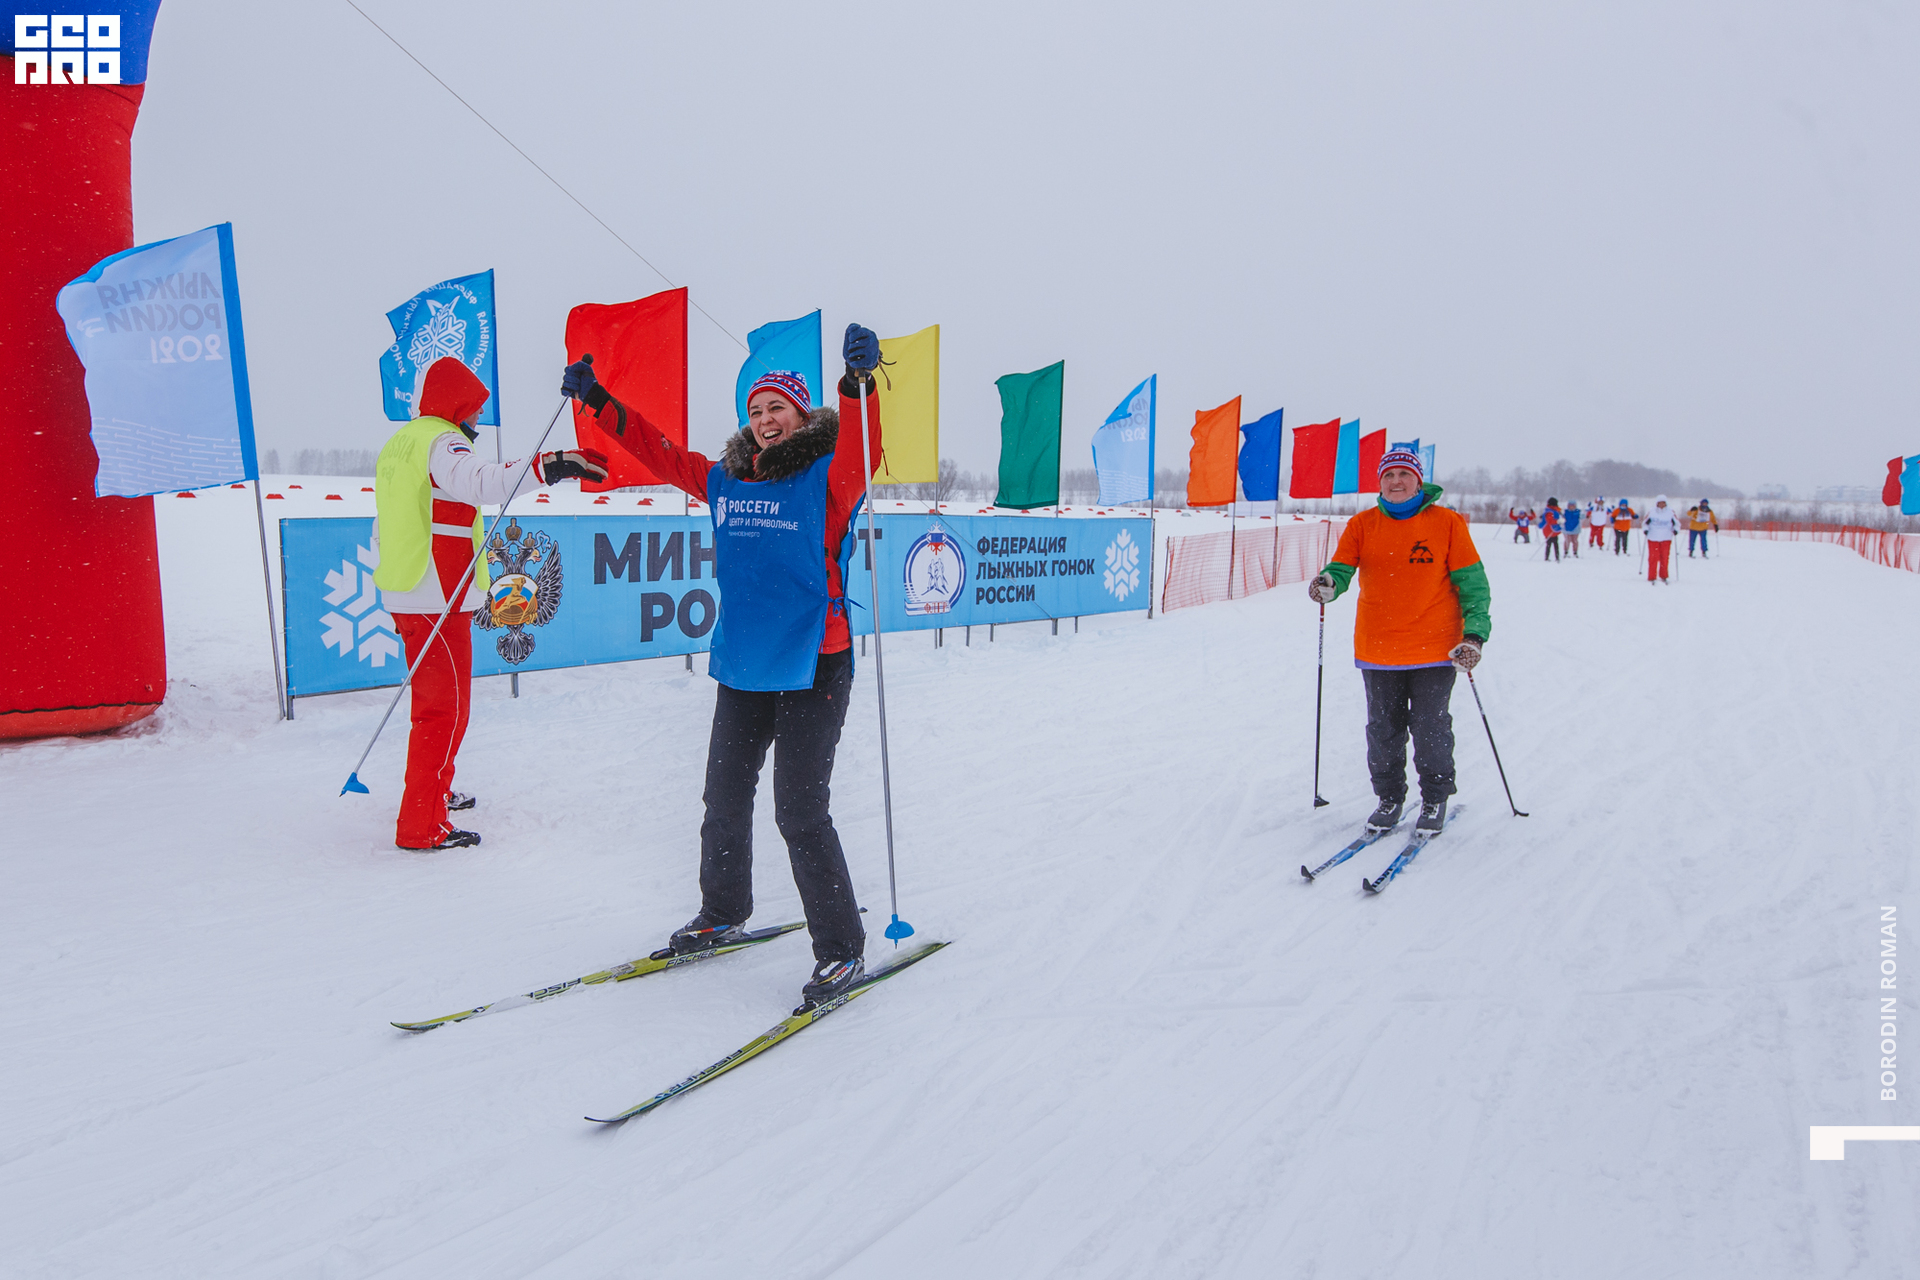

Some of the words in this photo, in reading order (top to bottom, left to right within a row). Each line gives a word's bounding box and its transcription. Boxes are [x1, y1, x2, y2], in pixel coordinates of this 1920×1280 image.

[728, 500, 780, 515] РОССЕТИ
[728, 517, 744, 527] ЦЕНТР
[745, 518, 750, 526] И
[751, 518, 799, 531] ПРИВОЛЖЬЕ
[977, 536, 1067, 557] ФЕДЕРАЦИЯ
[976, 560, 1047, 580] ЛЫЖНЫХ
[1051, 558, 1095, 577] ГОНОК
[976, 585, 1035, 605] РОССИИ
[664, 948, 718, 968] FISCHER
[811, 993, 850, 1022] FISCHER
